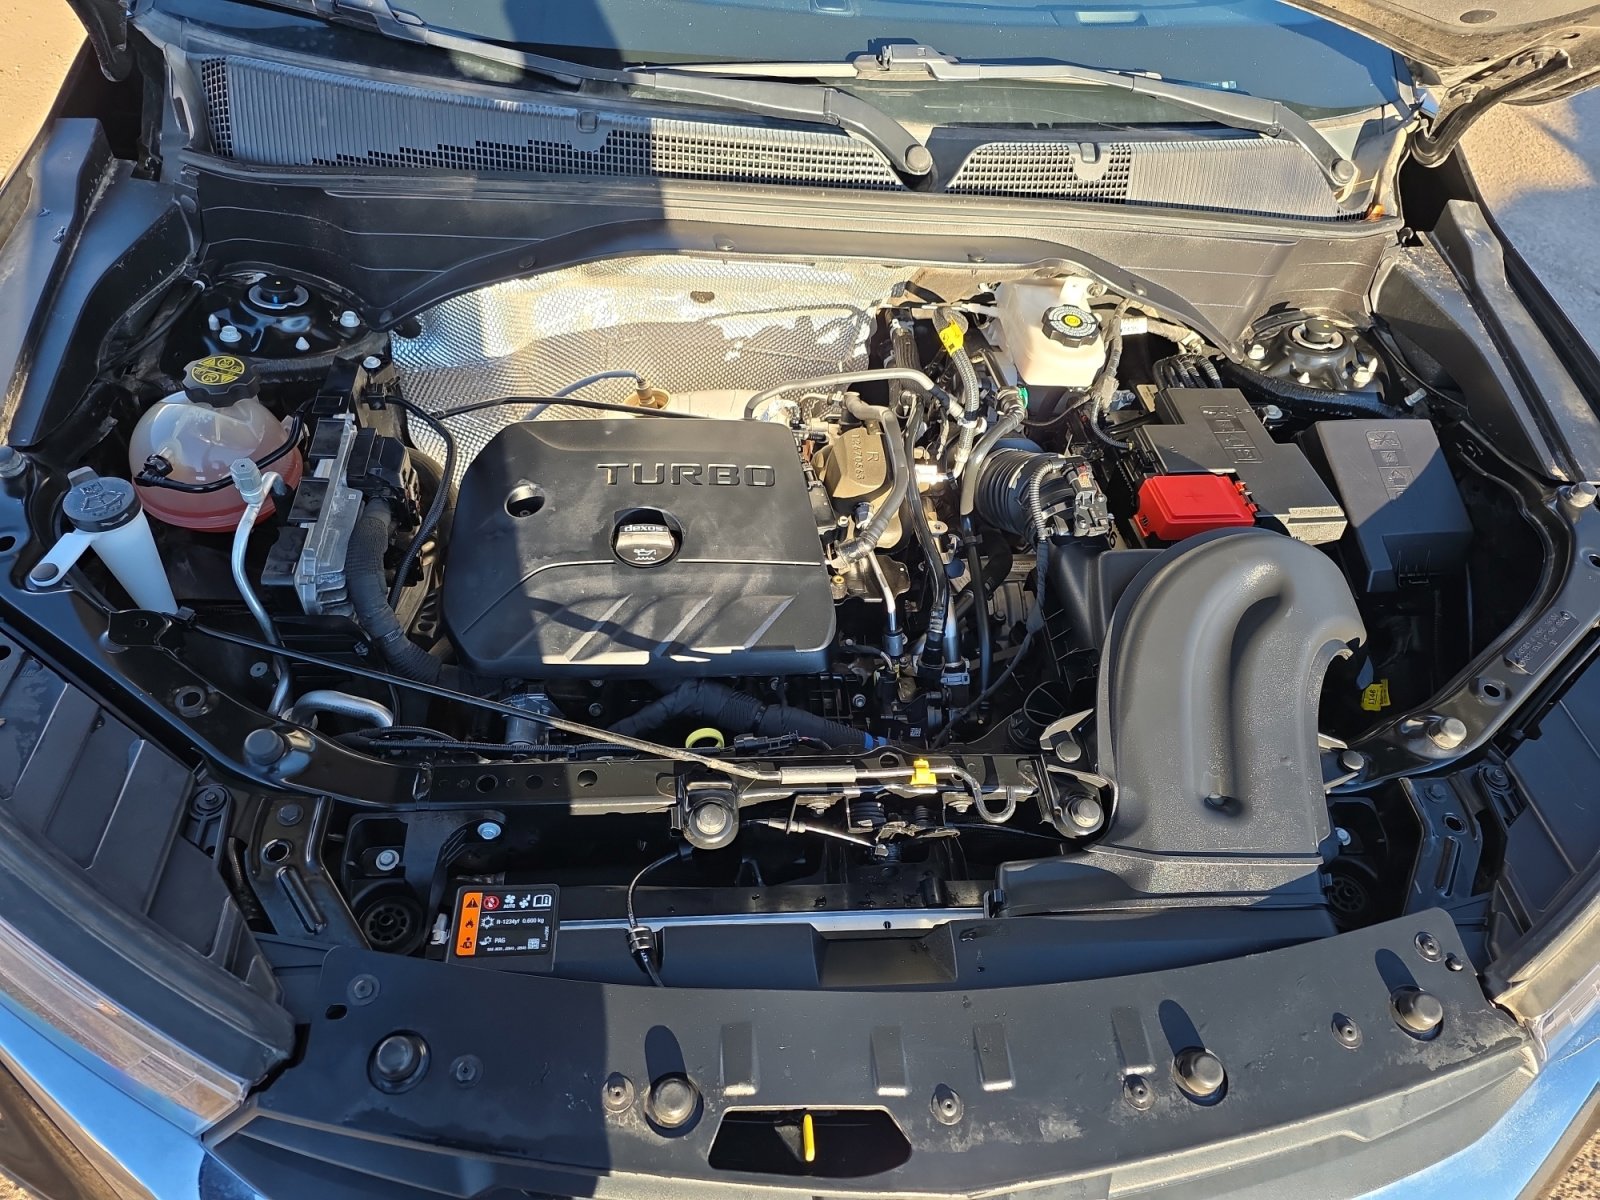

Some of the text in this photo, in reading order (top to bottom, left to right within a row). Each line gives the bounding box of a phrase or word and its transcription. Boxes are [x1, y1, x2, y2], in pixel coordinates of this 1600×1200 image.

[866, 450, 880, 463] R
[596, 463, 776, 487] TURBO
[624, 524, 664, 533] dexos
[496, 918, 520, 926] R-1234yf
